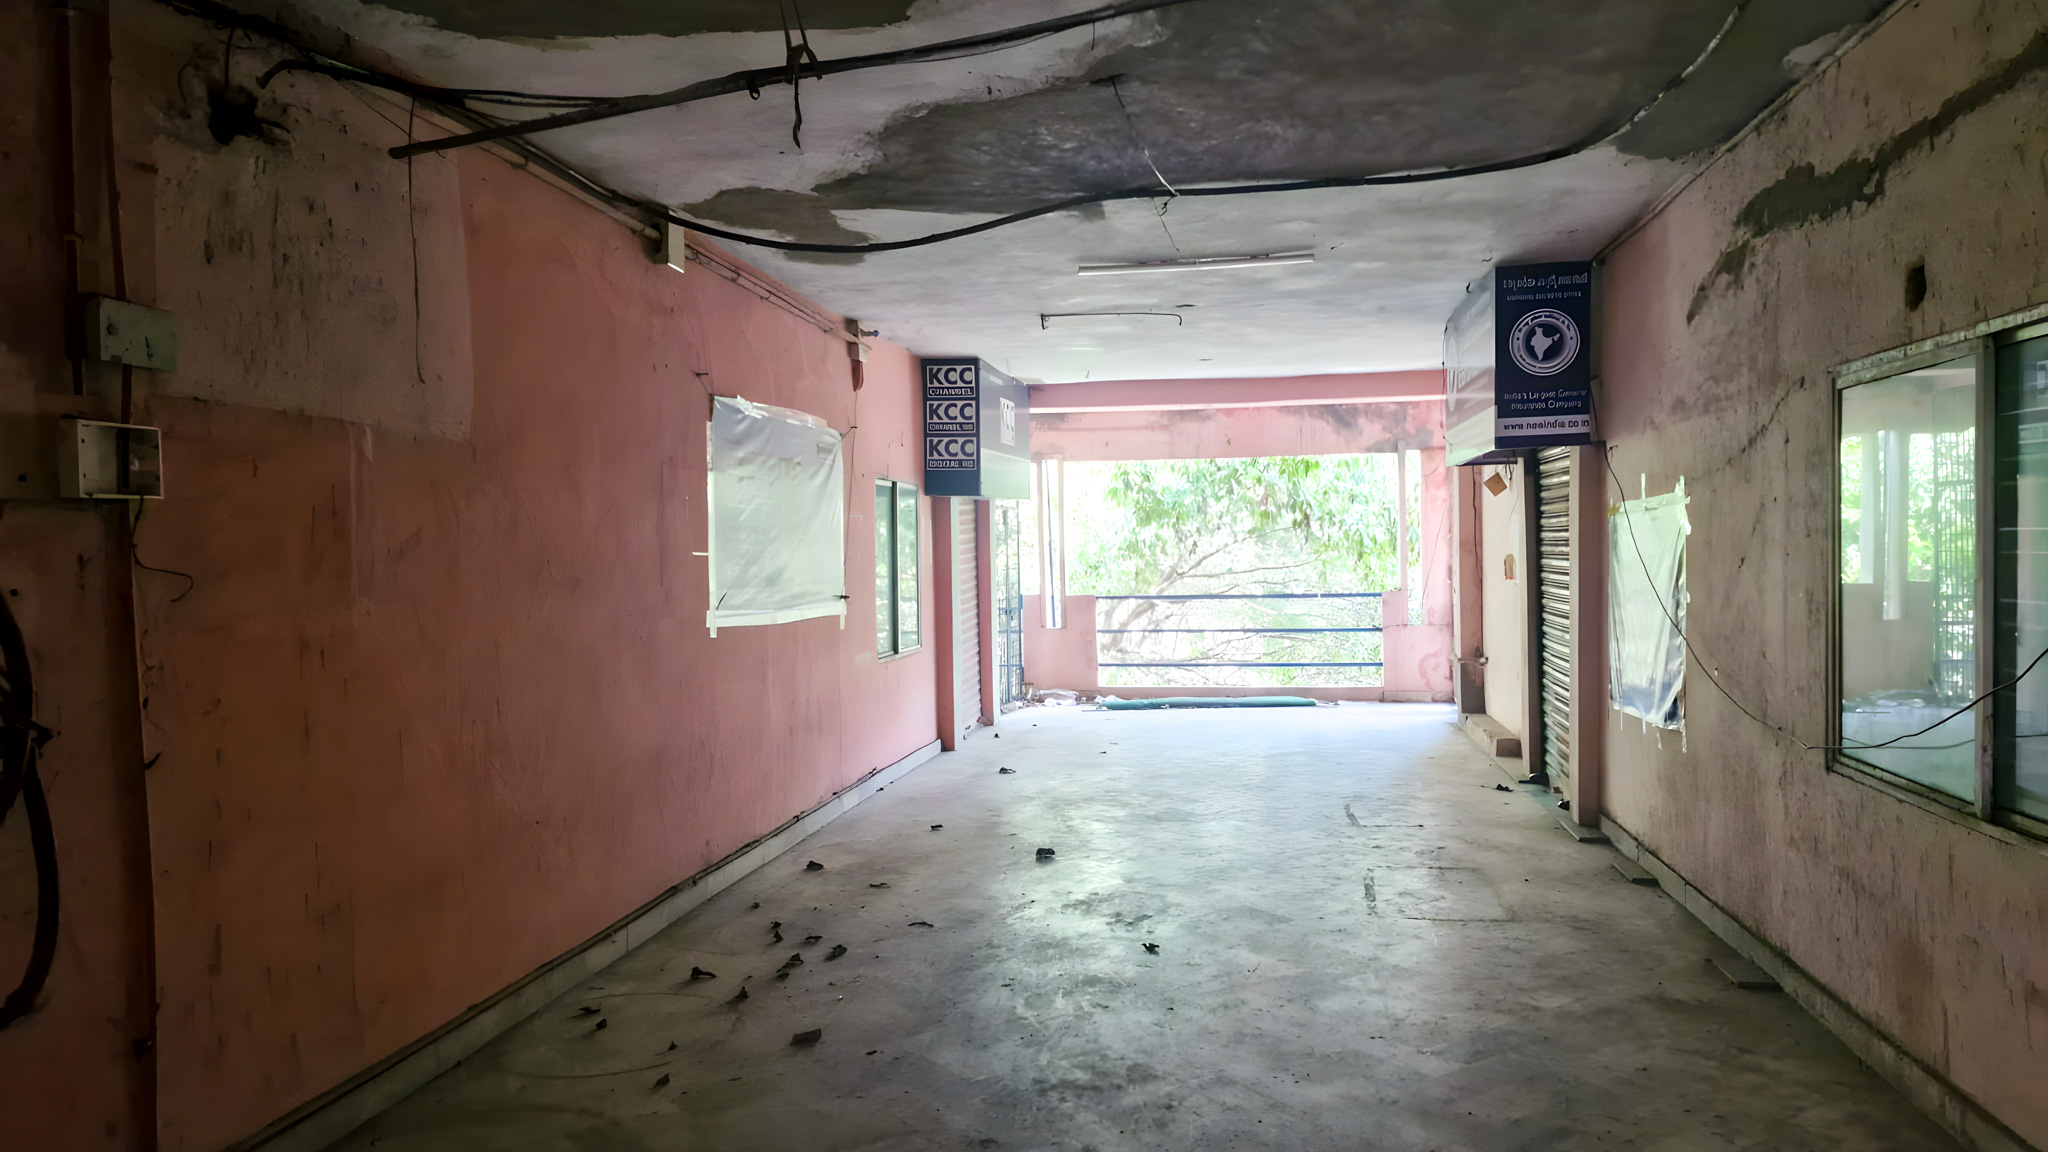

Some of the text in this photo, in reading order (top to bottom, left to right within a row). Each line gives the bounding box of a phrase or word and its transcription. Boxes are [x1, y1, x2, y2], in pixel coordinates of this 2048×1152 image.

[928, 367, 973, 386] KCC
[928, 403, 974, 421] KCC
[928, 438, 975, 458] KCC
